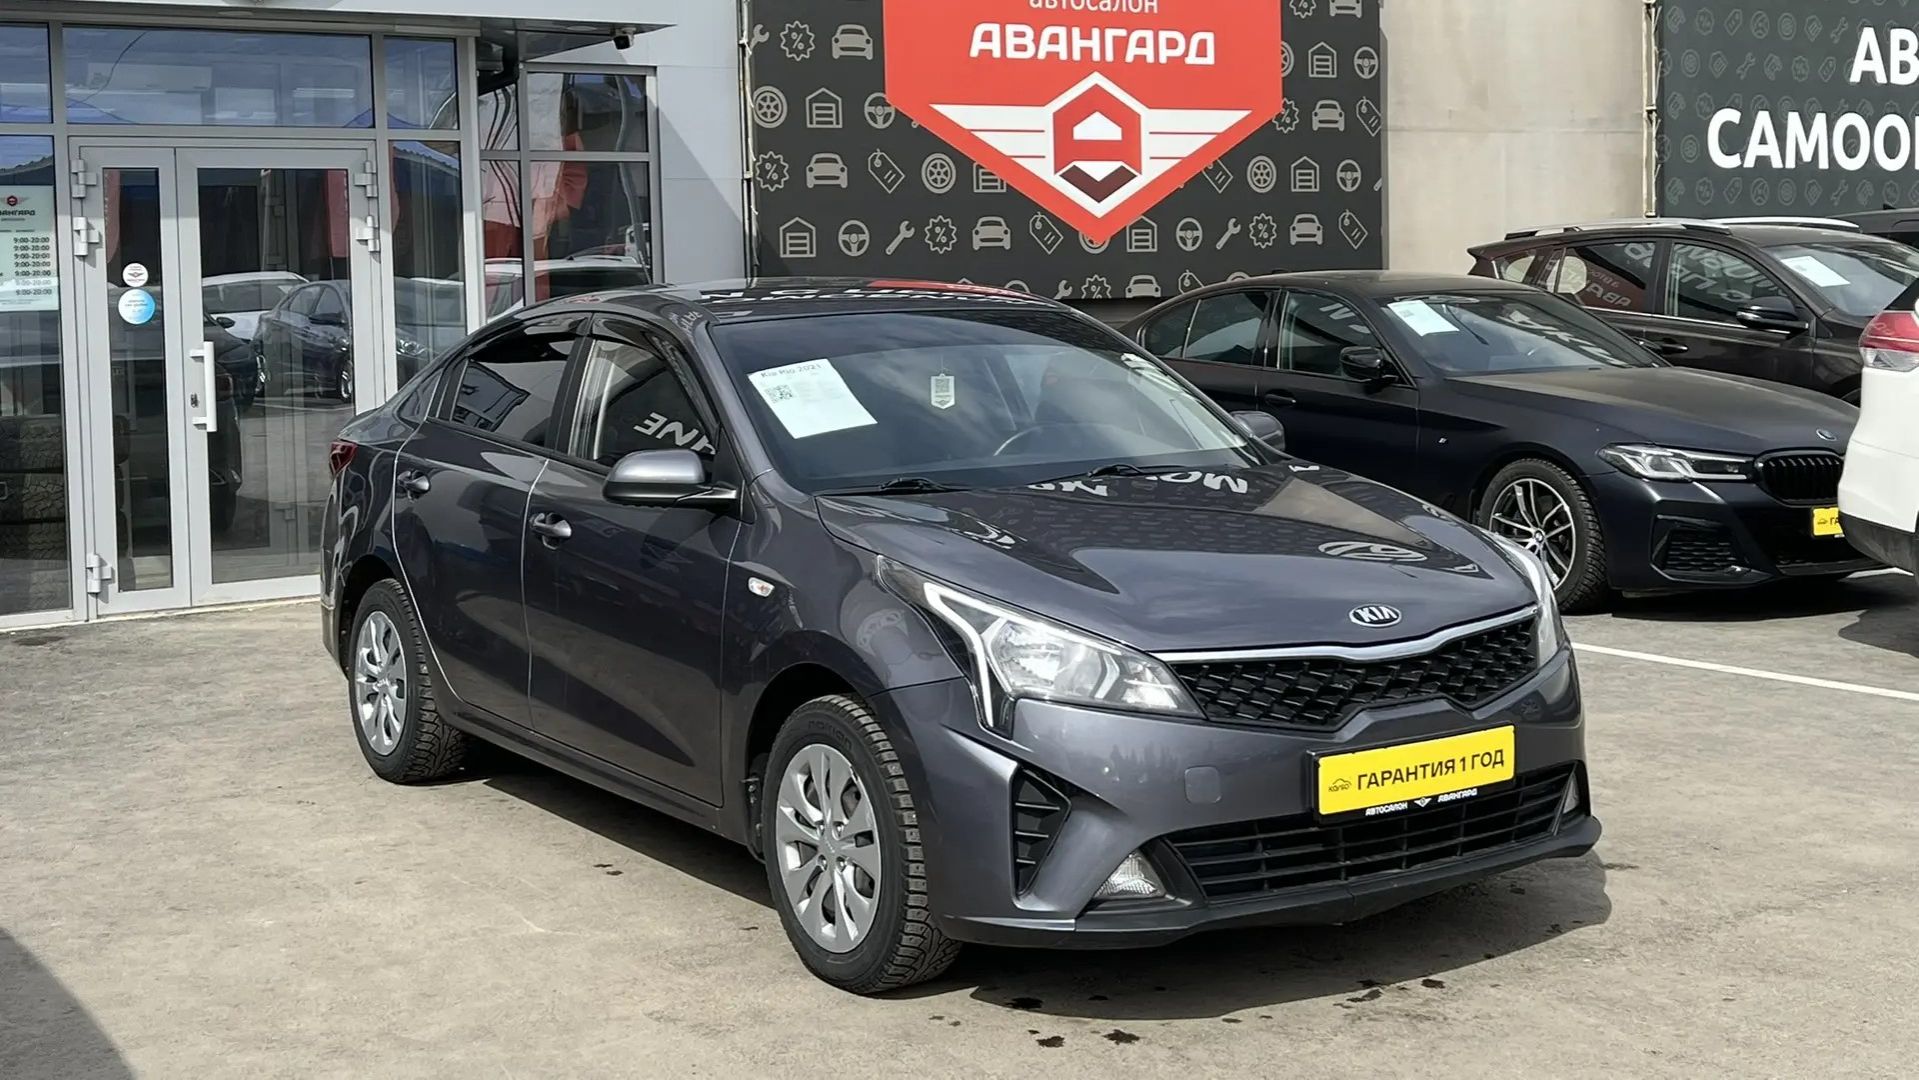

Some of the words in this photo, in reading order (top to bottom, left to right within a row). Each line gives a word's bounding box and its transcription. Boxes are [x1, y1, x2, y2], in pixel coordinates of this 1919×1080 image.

[969, 22, 1215, 65] АВАНГАРД
[1355, 606, 1398, 622] KIA
[1357, 758, 1456, 791] ГАРАНТИЯ
[1459, 756, 1467, 772] 1
[1471, 749, 1505, 770] ГОД
[1365, 801, 1409, 817] АВТОСАЛОН
[1437, 787, 1478, 803] АВАНГАРД
